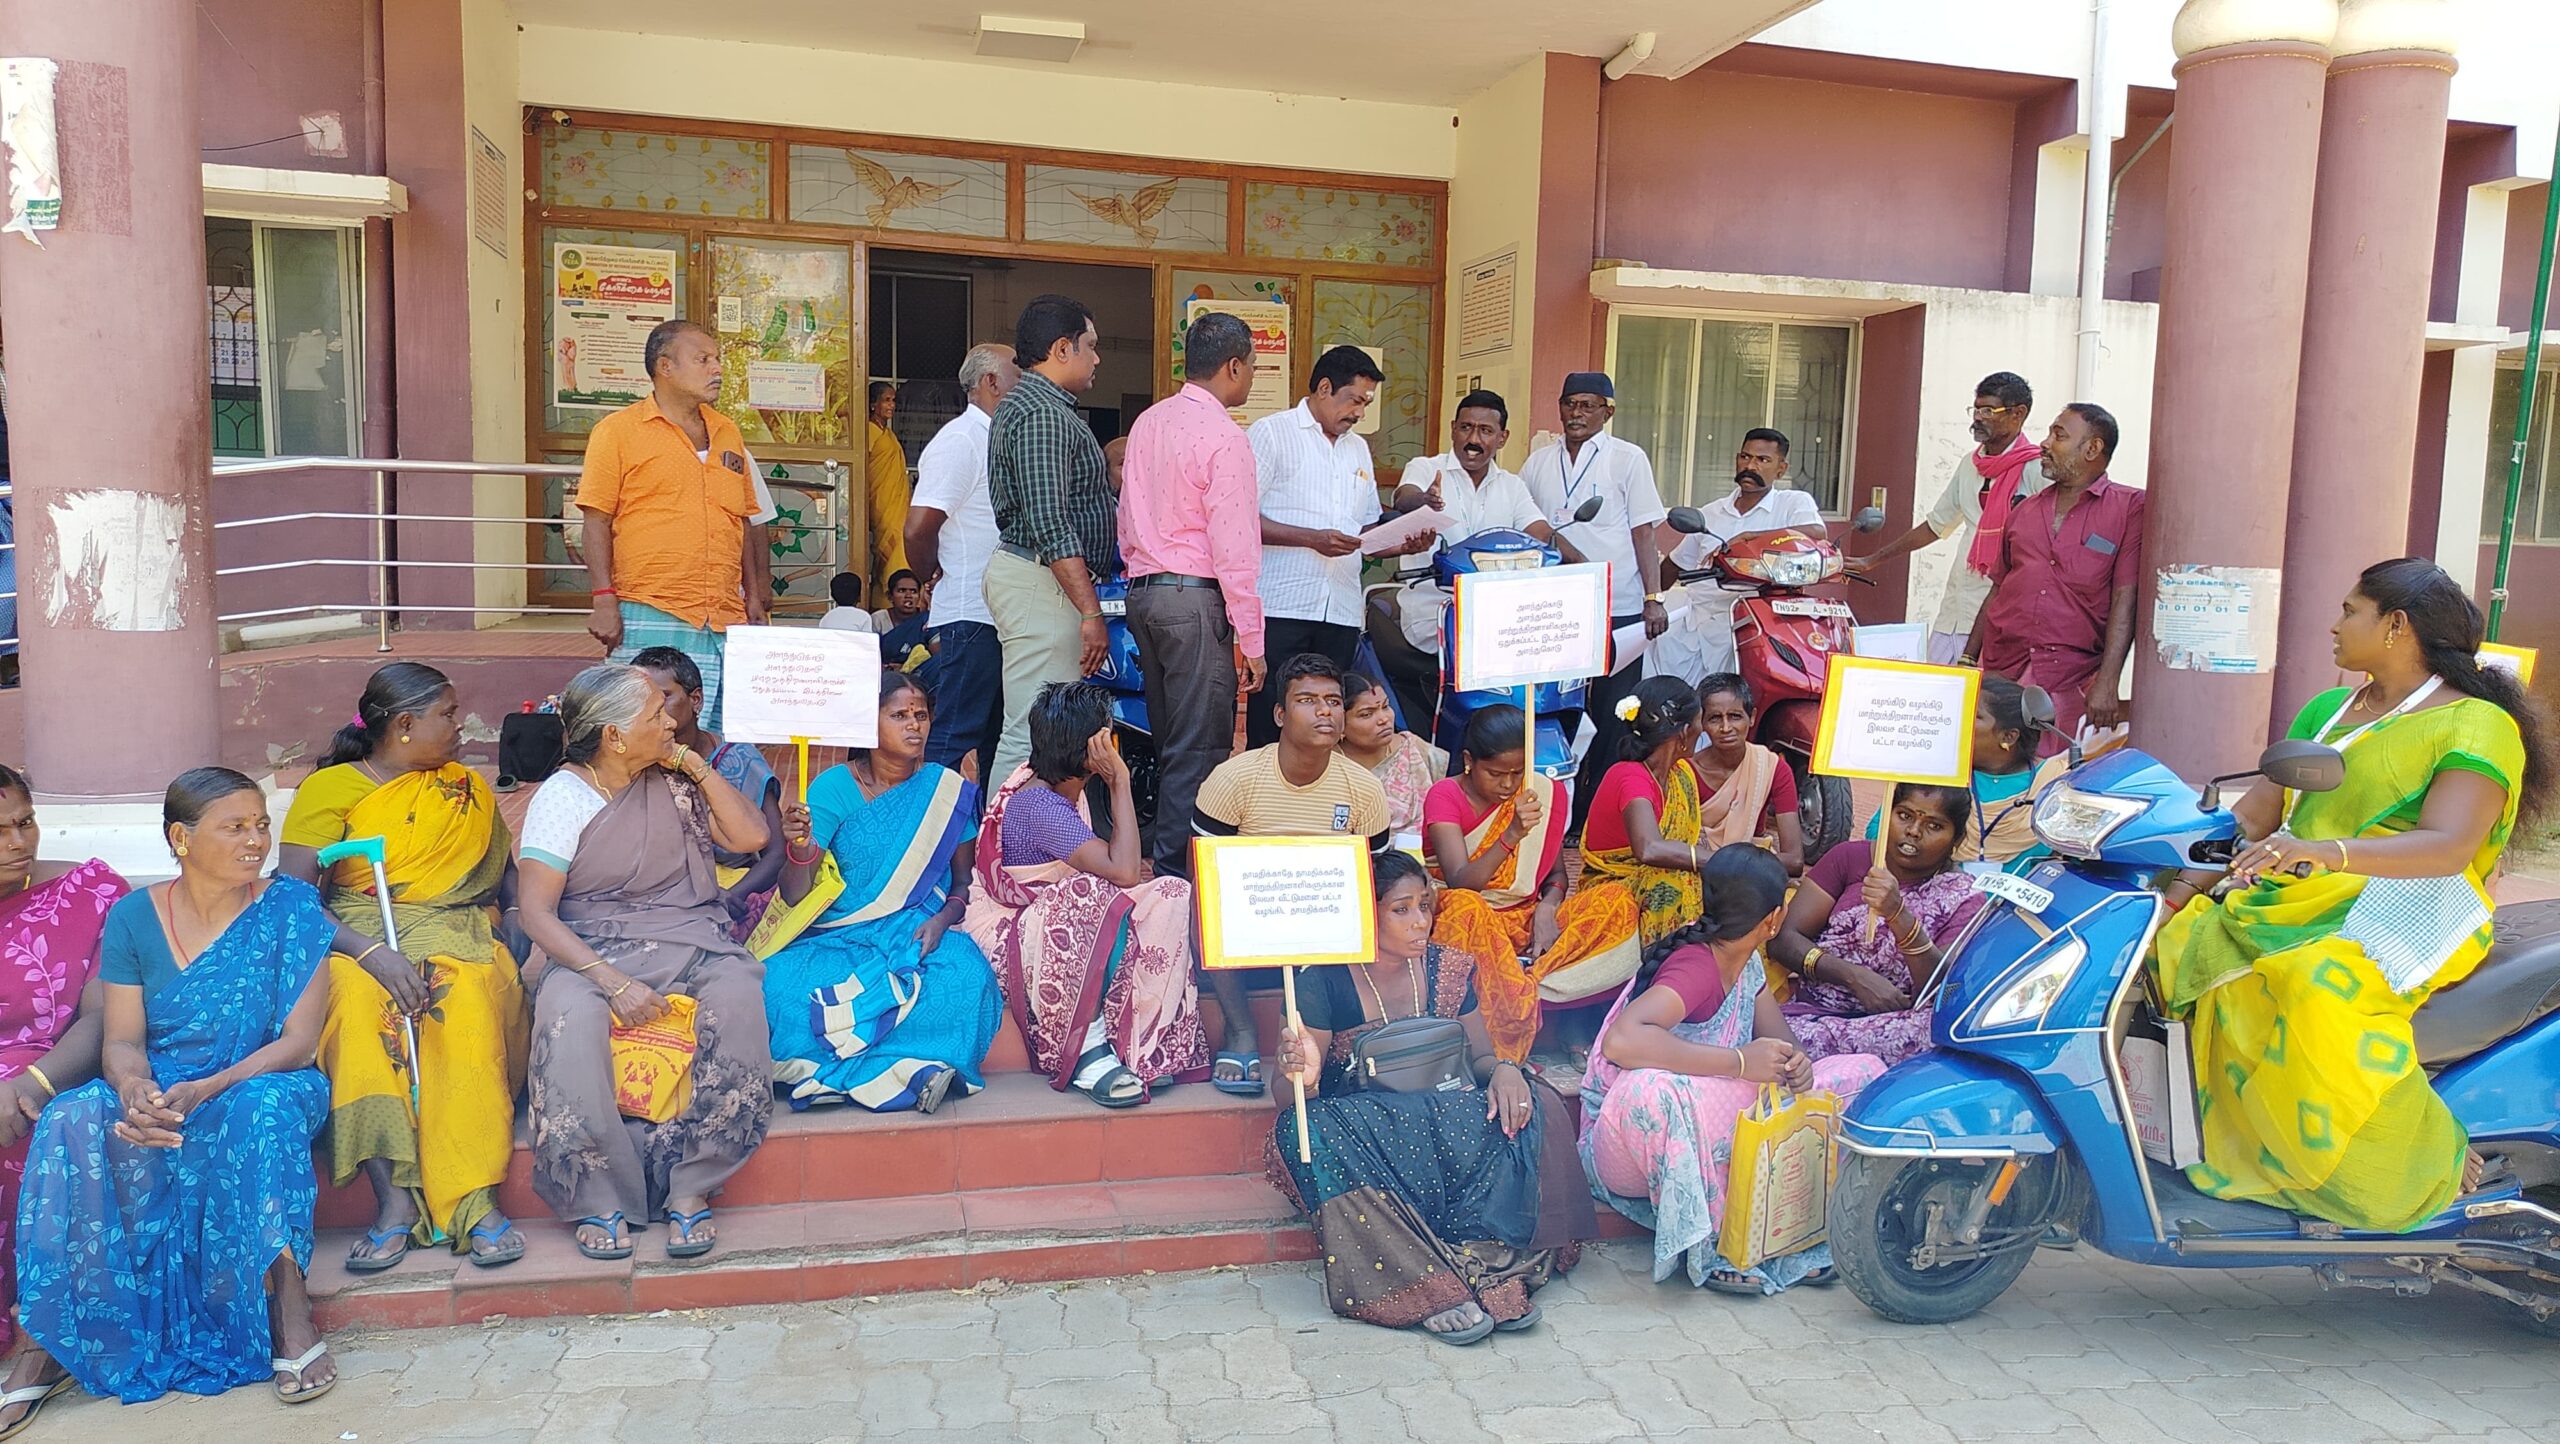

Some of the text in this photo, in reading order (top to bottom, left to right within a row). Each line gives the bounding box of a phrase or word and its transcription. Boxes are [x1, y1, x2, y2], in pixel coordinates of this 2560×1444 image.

[2174, 604, 2186, 612] 01
[2193, 605, 2207, 613] 01
[1871, 696, 1943, 711] வழங்கிடு வழங்கிடு
[1858, 709, 1952, 726] மாற்றுத்திறனாளிகளுக்கு
[1872, 736, 1932, 750] பட்டா வழங்கிடு
[1334, 815, 1348, 830] 62
[2042, 865, 2061, 877] TVS
[1322, 892, 1342, 901] பட்டா
[2018, 887, 2049, 908] 5410
[2138, 1123, 2166, 1144] Mills
